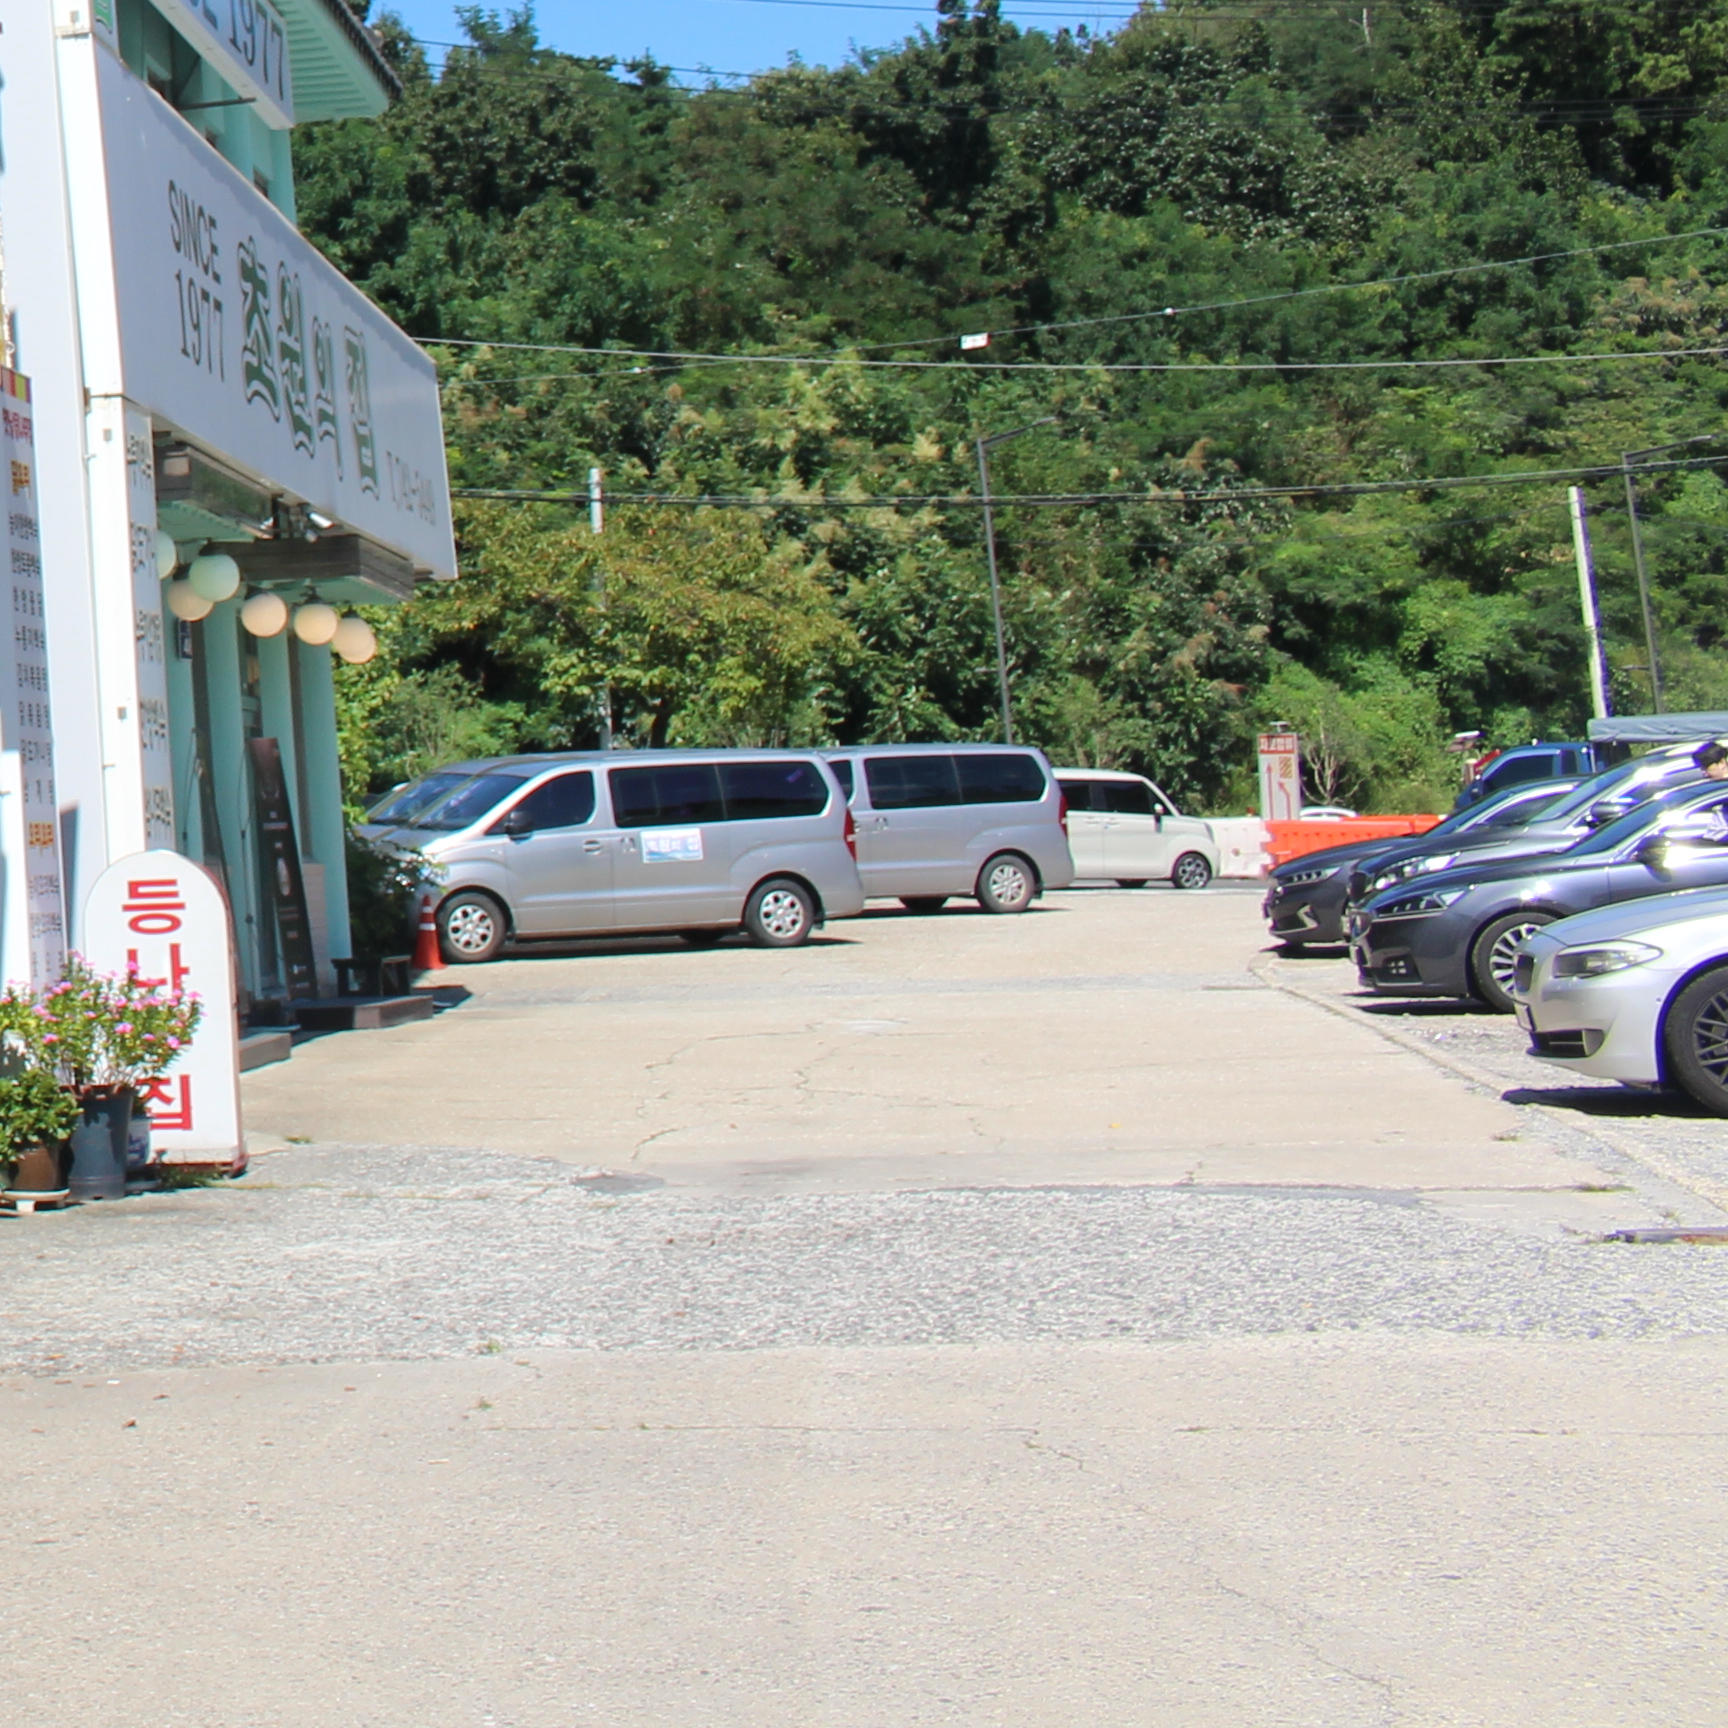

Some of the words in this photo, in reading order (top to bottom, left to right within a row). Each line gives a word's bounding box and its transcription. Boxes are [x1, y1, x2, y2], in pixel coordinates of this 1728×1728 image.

[168, 178, 222, 286] SINCE
[174, 268, 225, 384] 1977
[121, 877, 196, 1132] 등나집
